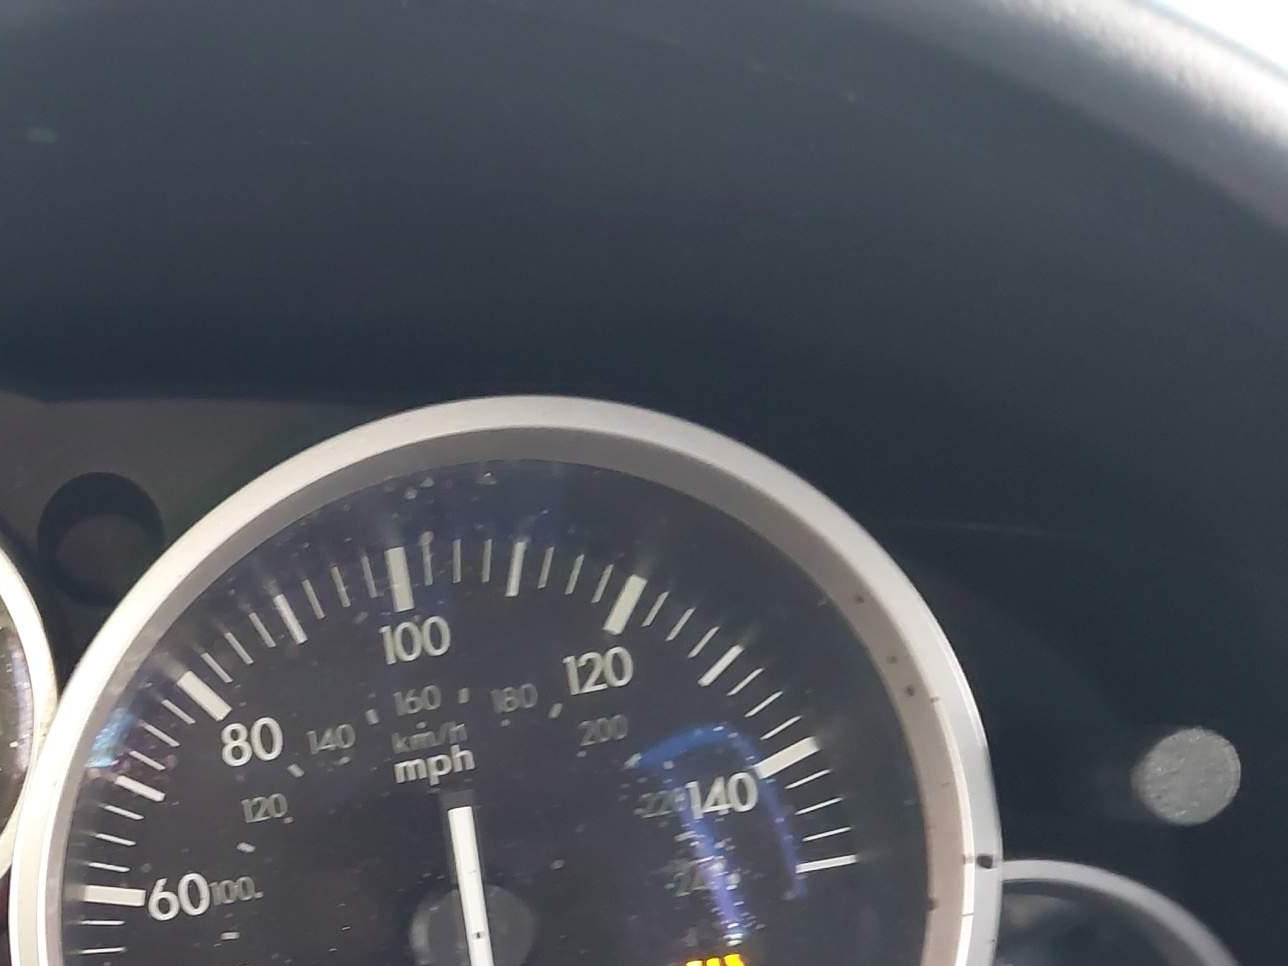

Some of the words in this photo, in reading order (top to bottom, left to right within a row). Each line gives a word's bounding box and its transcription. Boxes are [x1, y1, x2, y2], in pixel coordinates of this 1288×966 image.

[379, 616, 451, 665] 100
[563, 646, 634, 696] 120
[393, 685, 442, 716] 160
[490, 683, 538, 714] 180
[221, 716, 283, 767] 80
[306, 724, 356, 755] 140
[578, 714, 628, 746] 200
[393, 745, 476, 786] mph
[241, 793, 289, 824] 120
[685, 772, 758, 820] 140
[148, 872, 211, 921] 60
[210, 876, 255, 906] 100
